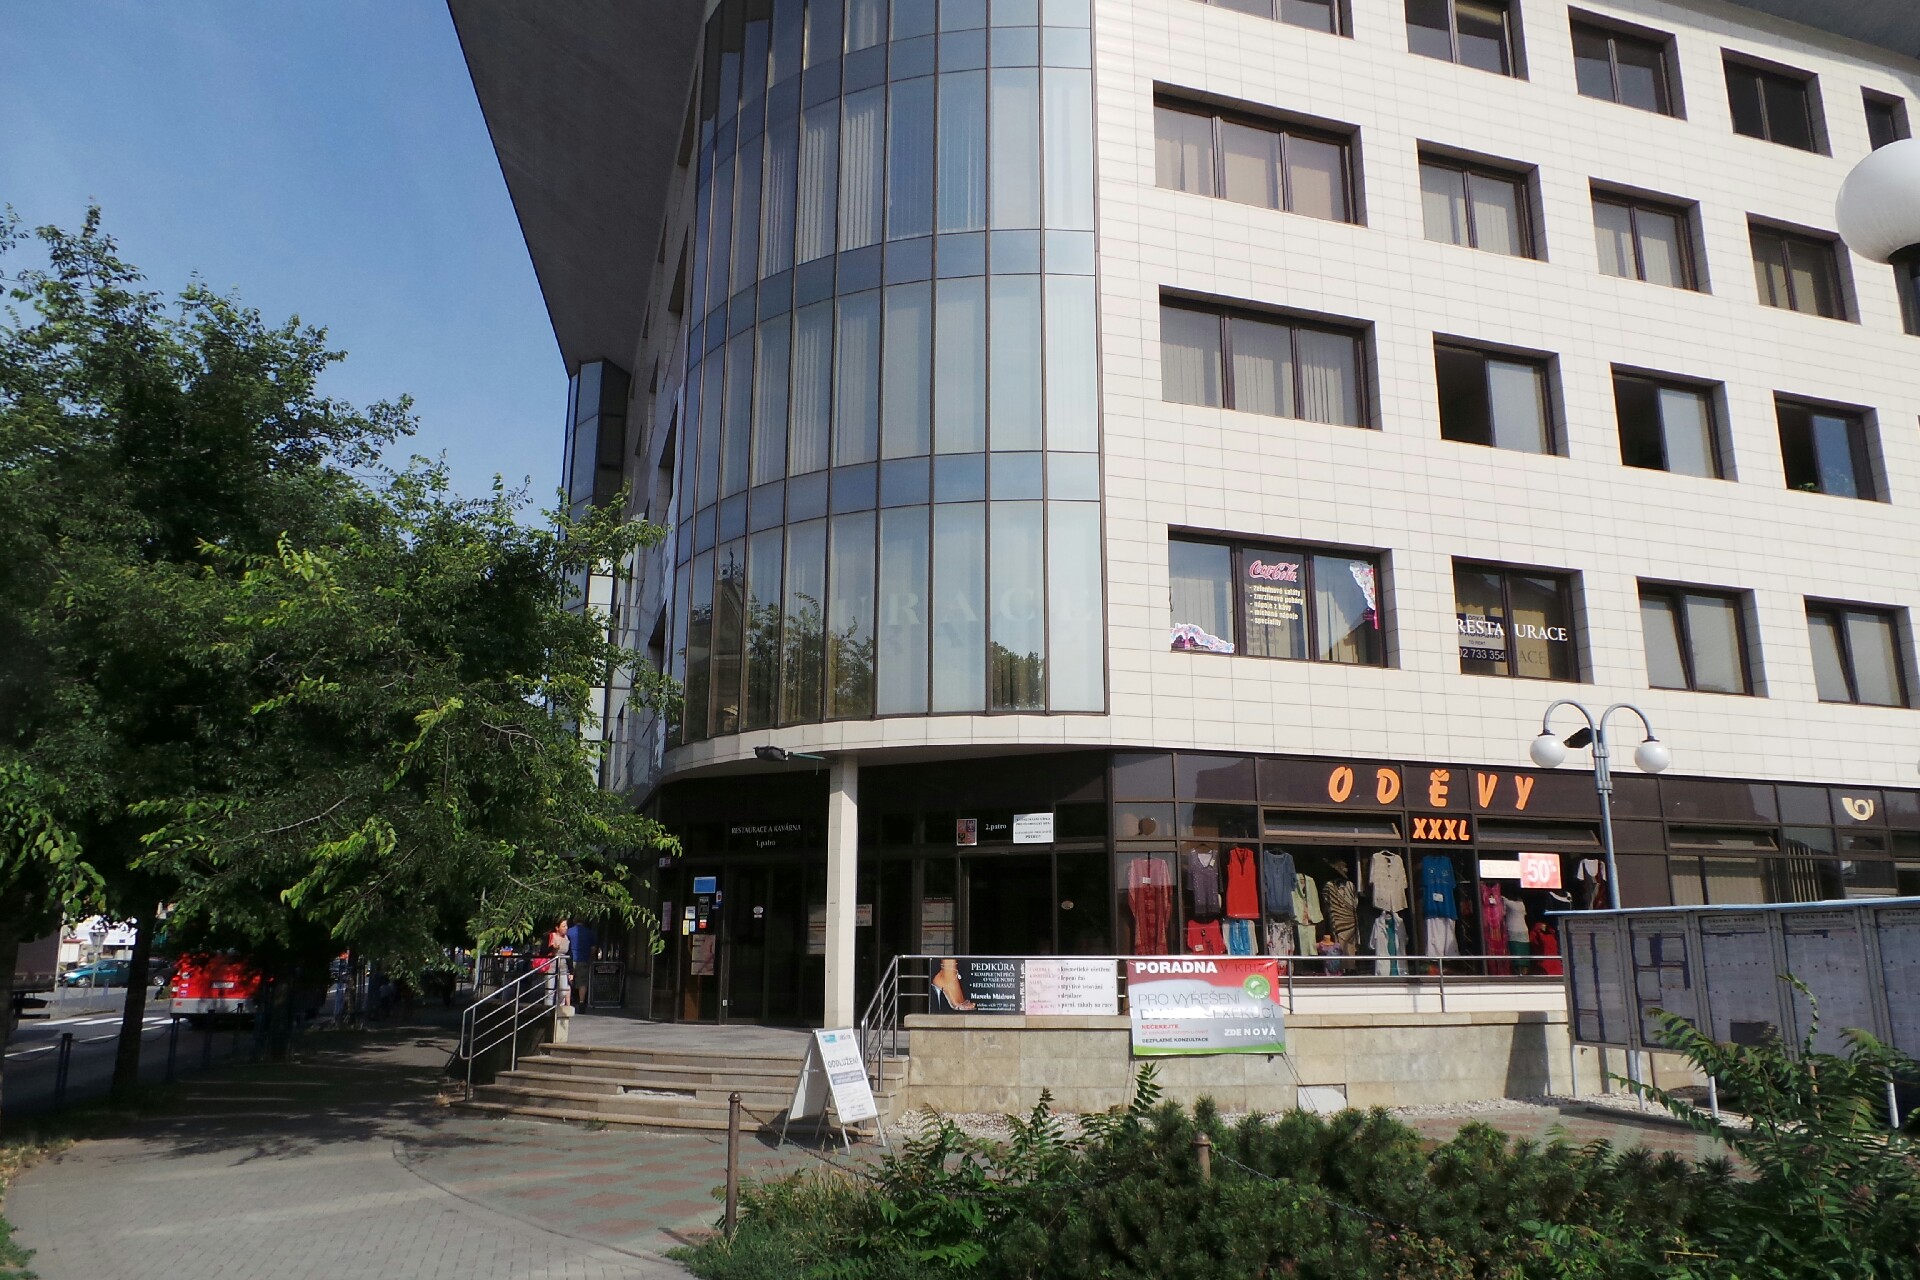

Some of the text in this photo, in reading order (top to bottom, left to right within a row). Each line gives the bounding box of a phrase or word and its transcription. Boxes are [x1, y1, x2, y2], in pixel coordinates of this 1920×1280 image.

[1249, 560, 1299, 581] Coca-Cola
[1284, 588, 1300, 597] saláty
[1254, 601, 1272, 609] nápoje
[1278, 603, 1291, 611] kávy
[1285, 597, 1303, 605] poháry
[1471, 649, 1487, 659] 733
[1489, 651, 1505, 661] 354
[1328, 766, 1534, 811] ODĚVY
[731, 826, 767, 834] RESTAURACE
[774, 822, 802, 831] KAVÁRNA
[1413, 818, 1470, 841] XXXL
[1136, 961, 1218, 974] PORADNA
[1138, 993, 1169, 1006] PRO
[1173, 990, 1240, 1005] VYŘEŠENÍ
[1224, 1026, 1276, 1037] ZDE NOVÁ
